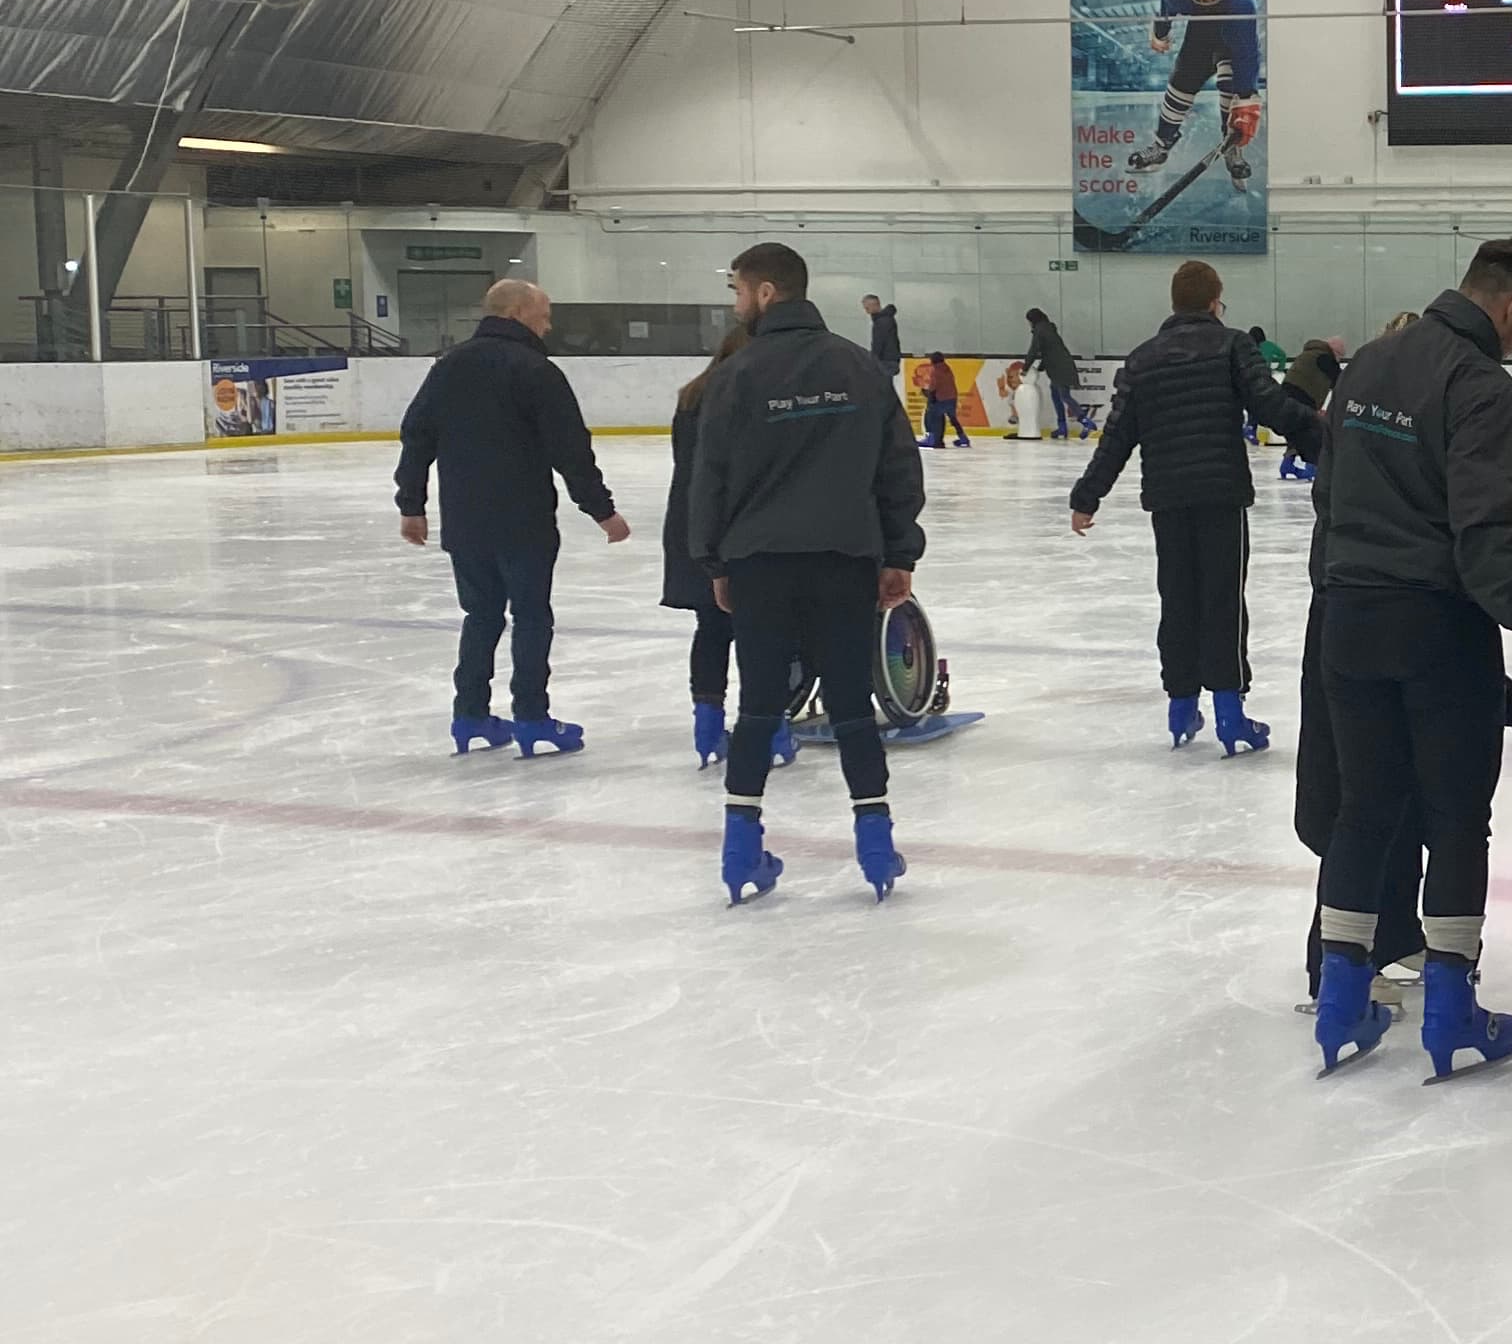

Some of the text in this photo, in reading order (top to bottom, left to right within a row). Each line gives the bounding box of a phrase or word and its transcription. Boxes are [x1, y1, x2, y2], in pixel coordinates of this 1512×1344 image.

[1077, 125, 1136, 144] Make
[1078, 150, 1114, 169] the
[1079, 178, 1139, 194] score
[1189, 226, 1262, 244] Riverside
[768, 399, 792, 411] Play
[824, 391, 848, 402] Part
[1346, 399, 1413, 428] Play Your Part
